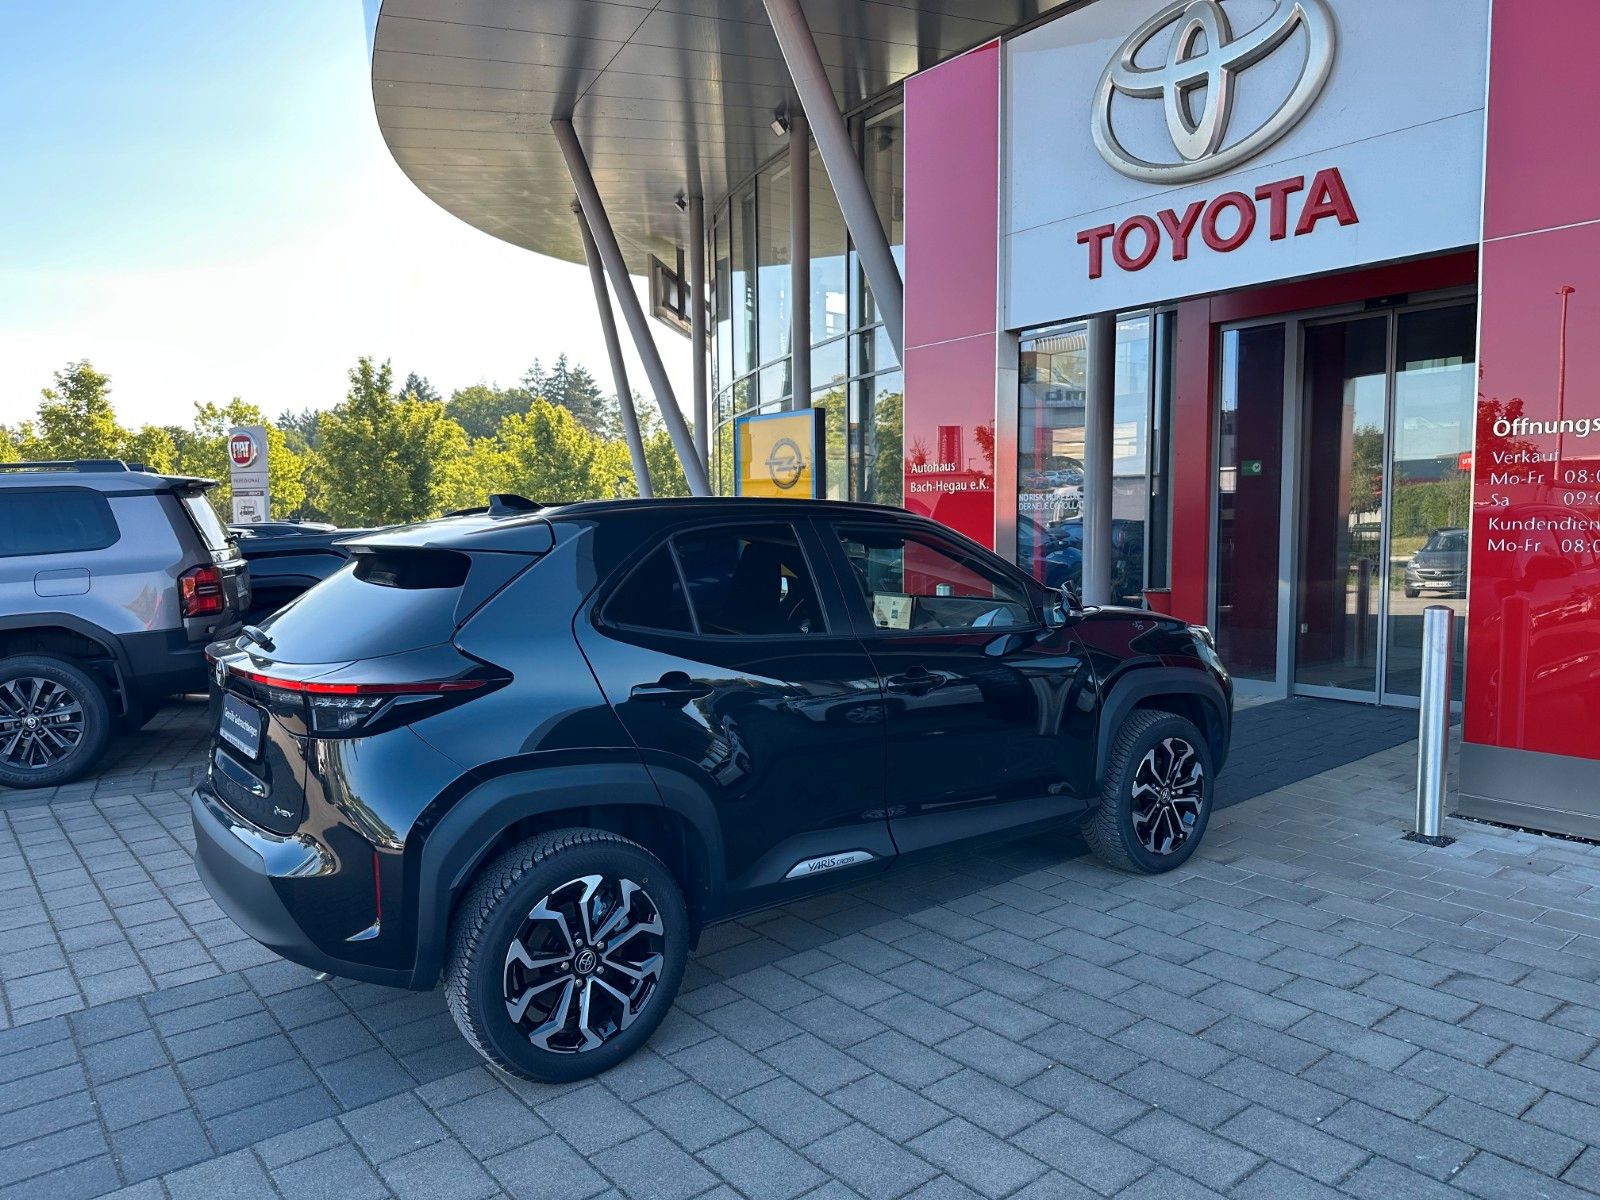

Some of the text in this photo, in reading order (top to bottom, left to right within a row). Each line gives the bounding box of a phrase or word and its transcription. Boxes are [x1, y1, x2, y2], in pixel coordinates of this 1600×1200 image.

[1077, 167, 1360, 279] TOYOTA
[1493, 416, 1600, 437] Öffnungs
[232, 441, 250, 459] FIAT
[1492, 449, 1559, 464] Verkauf
[911, 461, 956, 474] Autohaus
[1490, 470, 1545, 485] Mo-Fr
[910, 477, 989, 495] Bach-Hegau e.K.
[1490, 493, 1510, 507] Sa
[1487, 538, 1541, 552] Mo-Fr
[807, 855, 855, 872] YARIS CROSS
